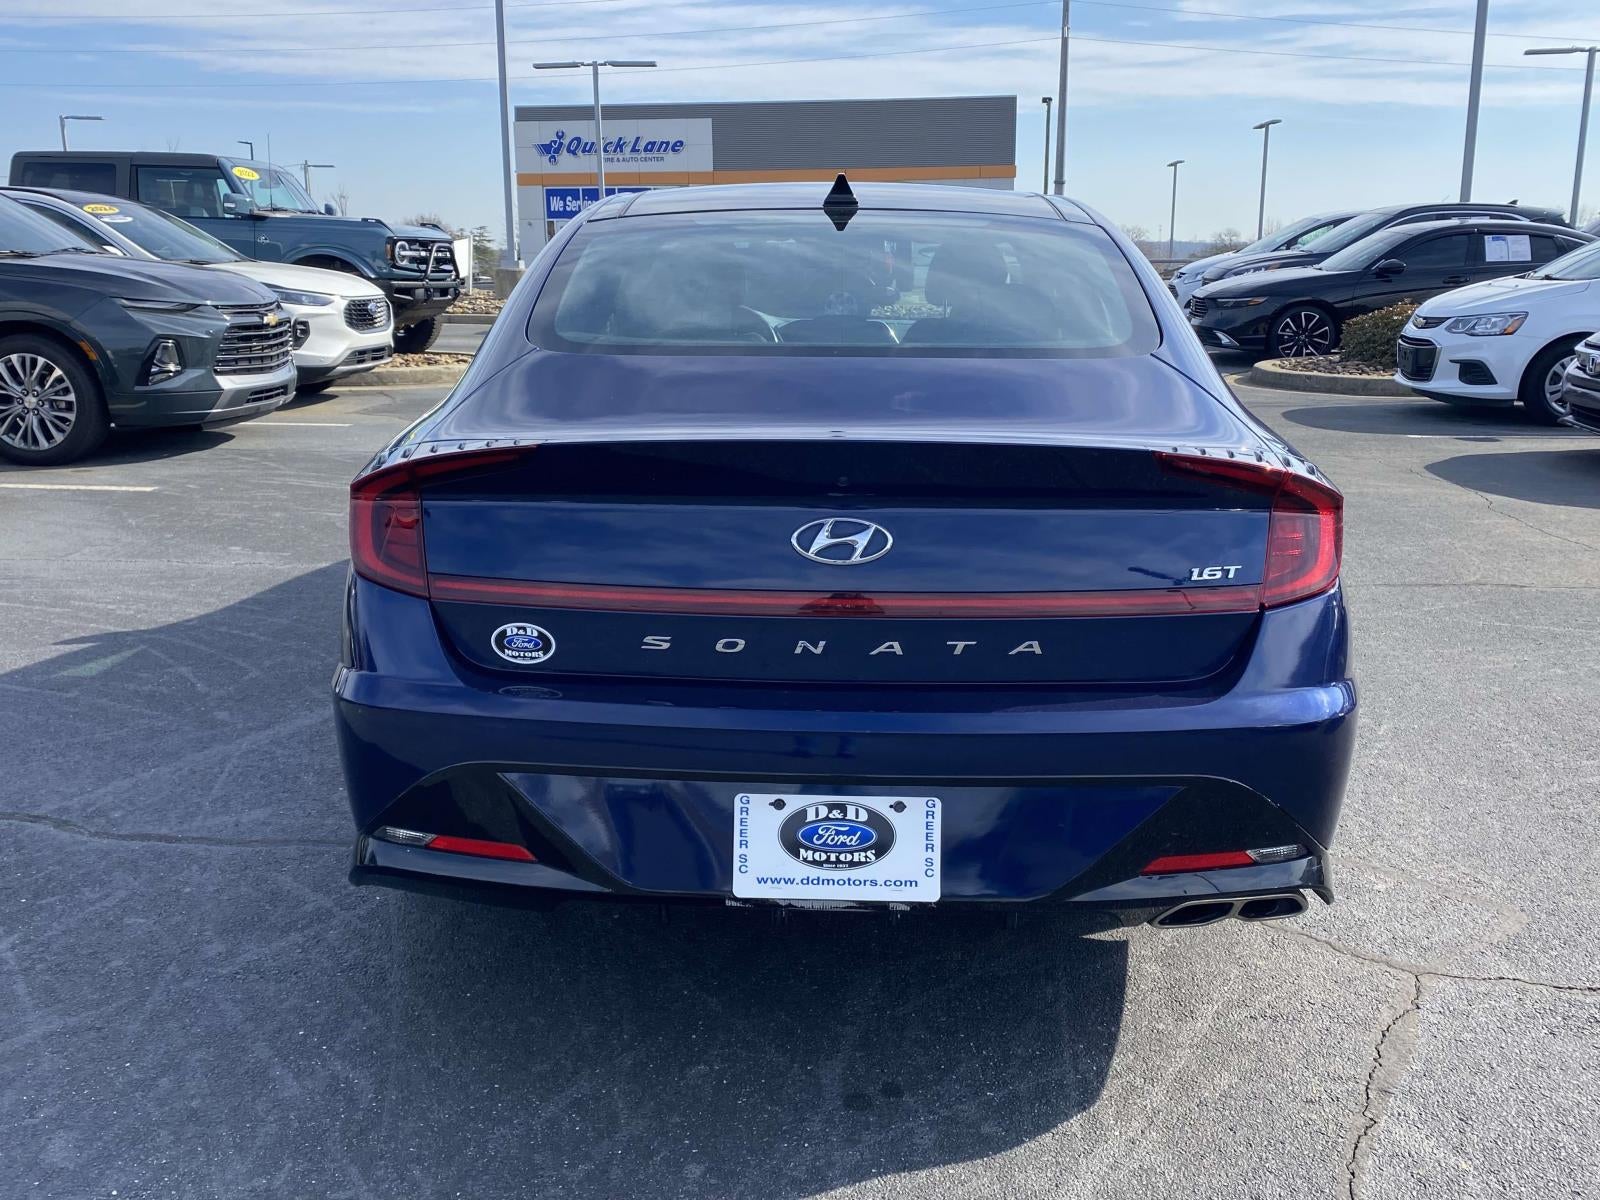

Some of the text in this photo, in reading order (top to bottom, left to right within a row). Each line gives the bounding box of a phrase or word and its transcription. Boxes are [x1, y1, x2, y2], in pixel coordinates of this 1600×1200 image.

[566, 136, 684, 155] Quck Lane
[550, 196, 564, 211] We
[506, 626, 538, 637] D&D
[511, 637, 535, 648] Ford
[641, 635, 1043, 655] SONATA
[504, 649, 544, 658] MOTORS
[805, 804, 869, 822] D&D
[738, 795, 750, 874] GREER SC
[813, 825, 861, 846] Ford
[924, 799, 936, 878] GREER SC
[799, 847, 876, 863] MOTORS
[756, 875, 919, 888] www.ddmotors.com
